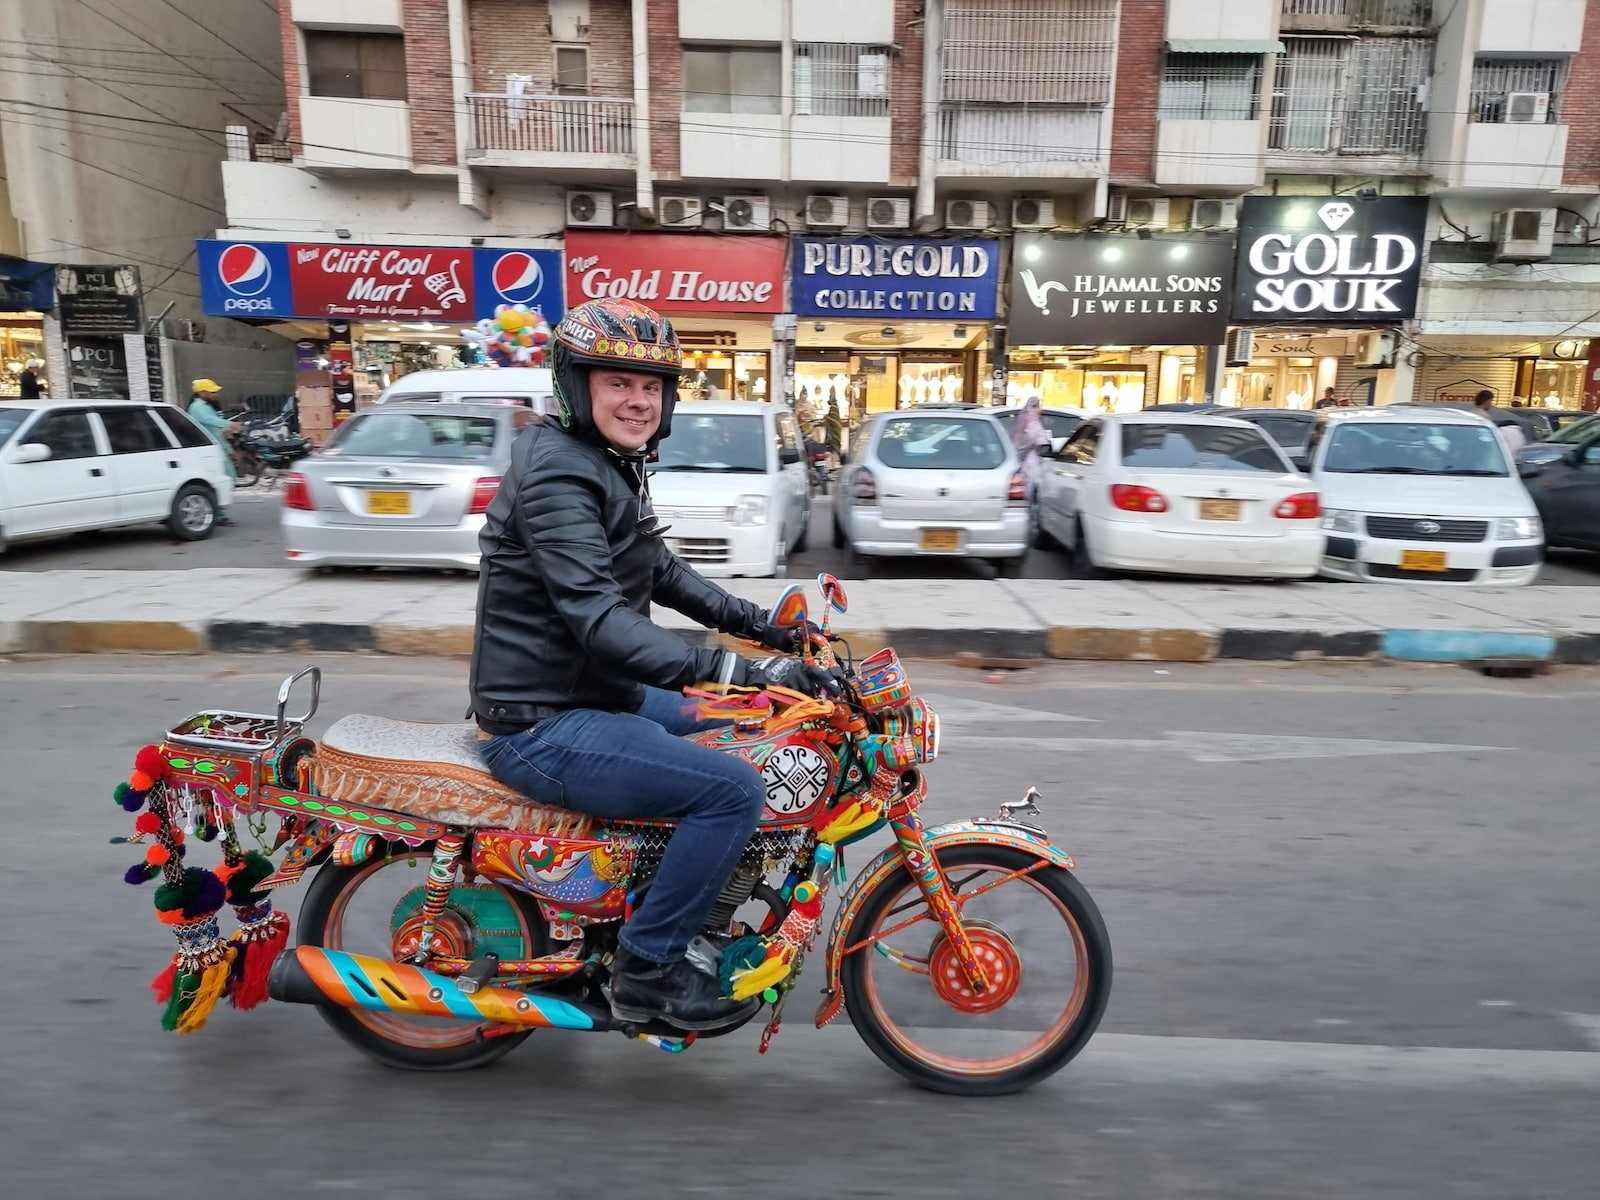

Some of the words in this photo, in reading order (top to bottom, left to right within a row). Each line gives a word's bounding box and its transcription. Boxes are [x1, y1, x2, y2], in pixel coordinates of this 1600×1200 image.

[296, 248, 320, 264] New
[321, 248, 380, 273] Cliff
[381, 250, 432, 275] Cool
[569, 255, 599, 273] New
[803, 242, 990, 278] PUREGOLD
[1248, 233, 1417, 276] GOLD
[346, 277, 413, 302] Mart
[581, 268, 662, 301] Gold
[667, 270, 773, 304] House
[1166, 274, 1222, 292] SONS
[224, 297, 273, 312] pepsi
[815, 289, 977, 312] COLLECTION
[1252, 278, 1402, 313] SOUK
[1070, 298, 1219, 317] JEWELLERS
[565, 319, 597, 342] МИР
[83, 348, 115, 367] PCJ
[1270, 339, 1323, 356] Souk
